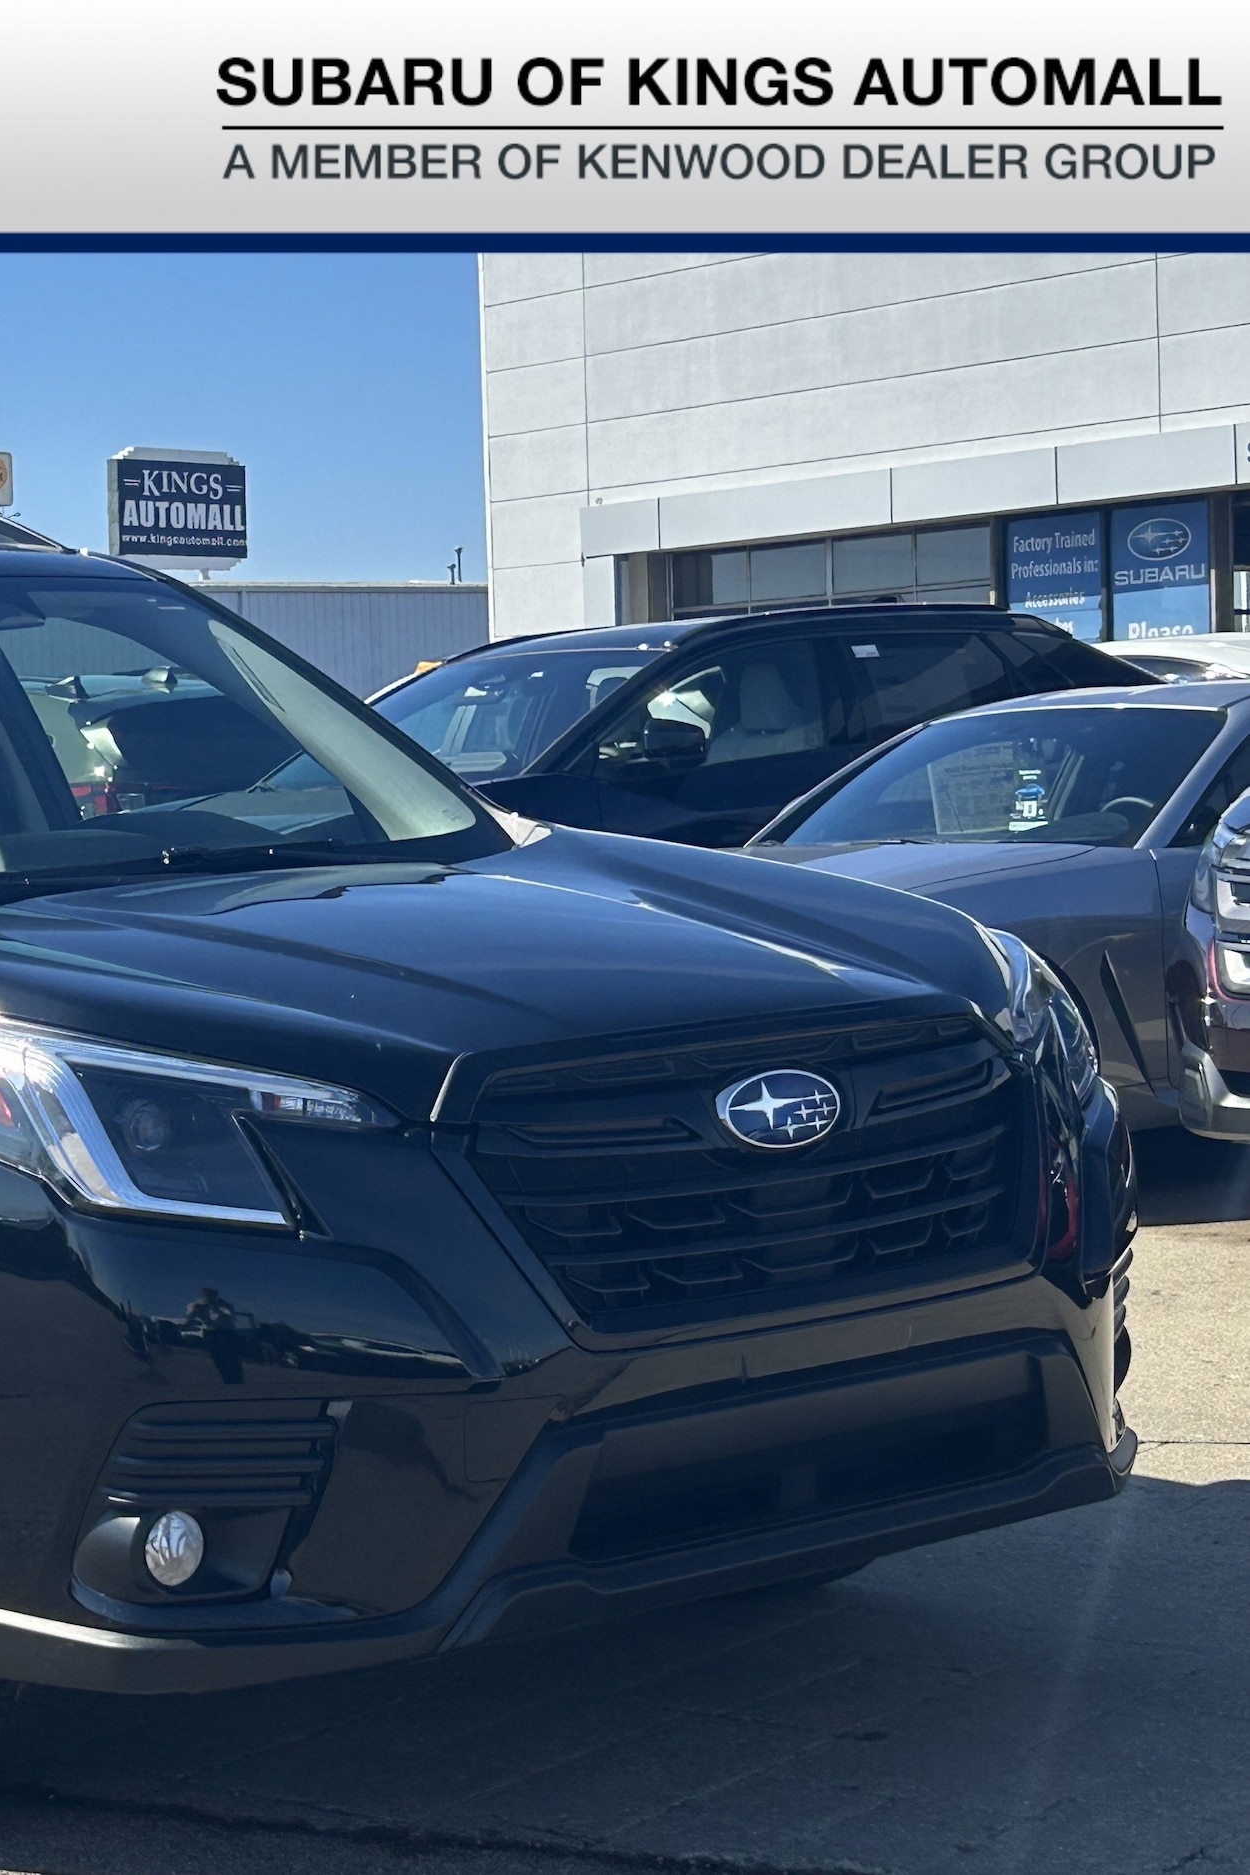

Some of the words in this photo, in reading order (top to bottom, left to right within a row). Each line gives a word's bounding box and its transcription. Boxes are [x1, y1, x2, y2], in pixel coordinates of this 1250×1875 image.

[142, 469, 223, 500] KINGS
[123, 499, 245, 531] AUTOMALL
[1013, 536, 1053, 554] Factory
[1054, 528, 1095, 549] Trained
[1011, 556, 1082, 579] Professionals
[1083, 555, 1099, 573] in:
[1114, 563, 1205, 586] SUBARU
[1024, 587, 1085, 608] Accessories
